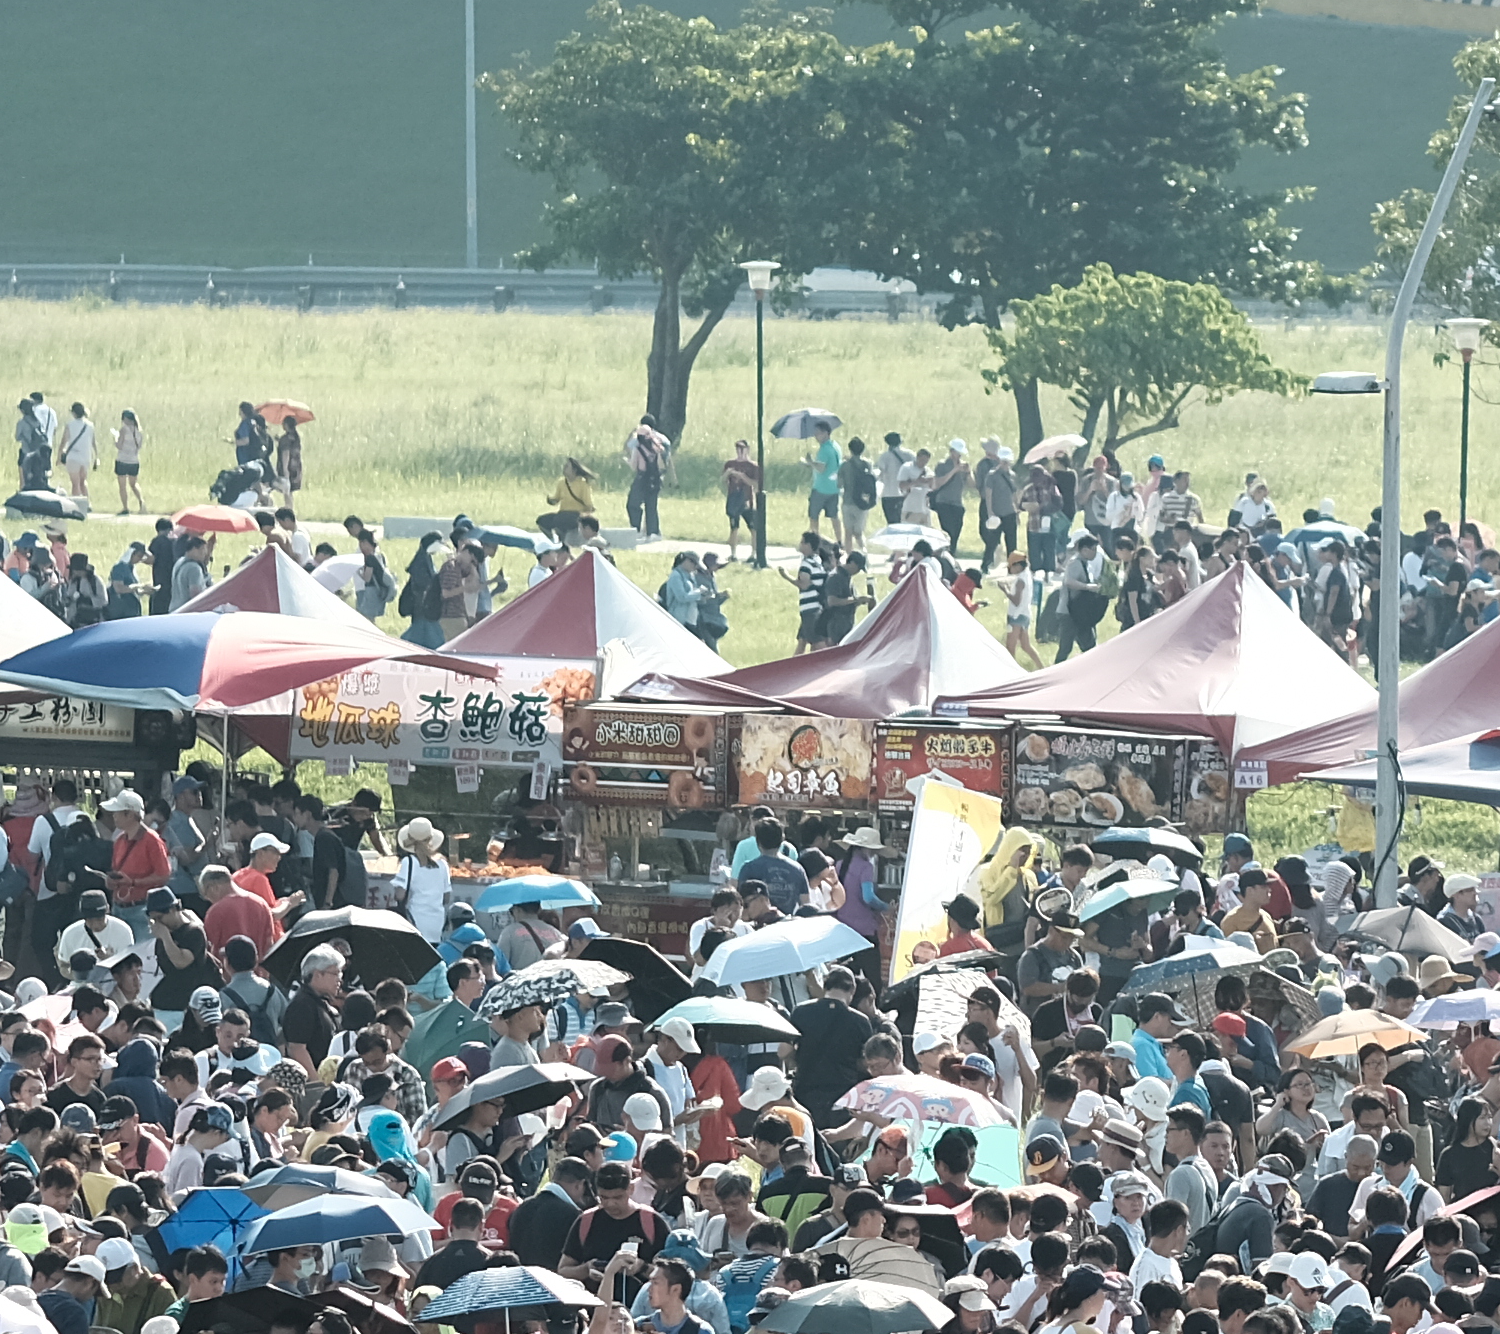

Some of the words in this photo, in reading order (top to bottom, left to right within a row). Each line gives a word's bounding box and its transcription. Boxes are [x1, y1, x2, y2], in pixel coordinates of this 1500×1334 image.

[300, 695, 401, 749] 地瓜球
[416, 689, 553, 745] 杏鮑菇
[1239, 775, 1263, 785] A16
